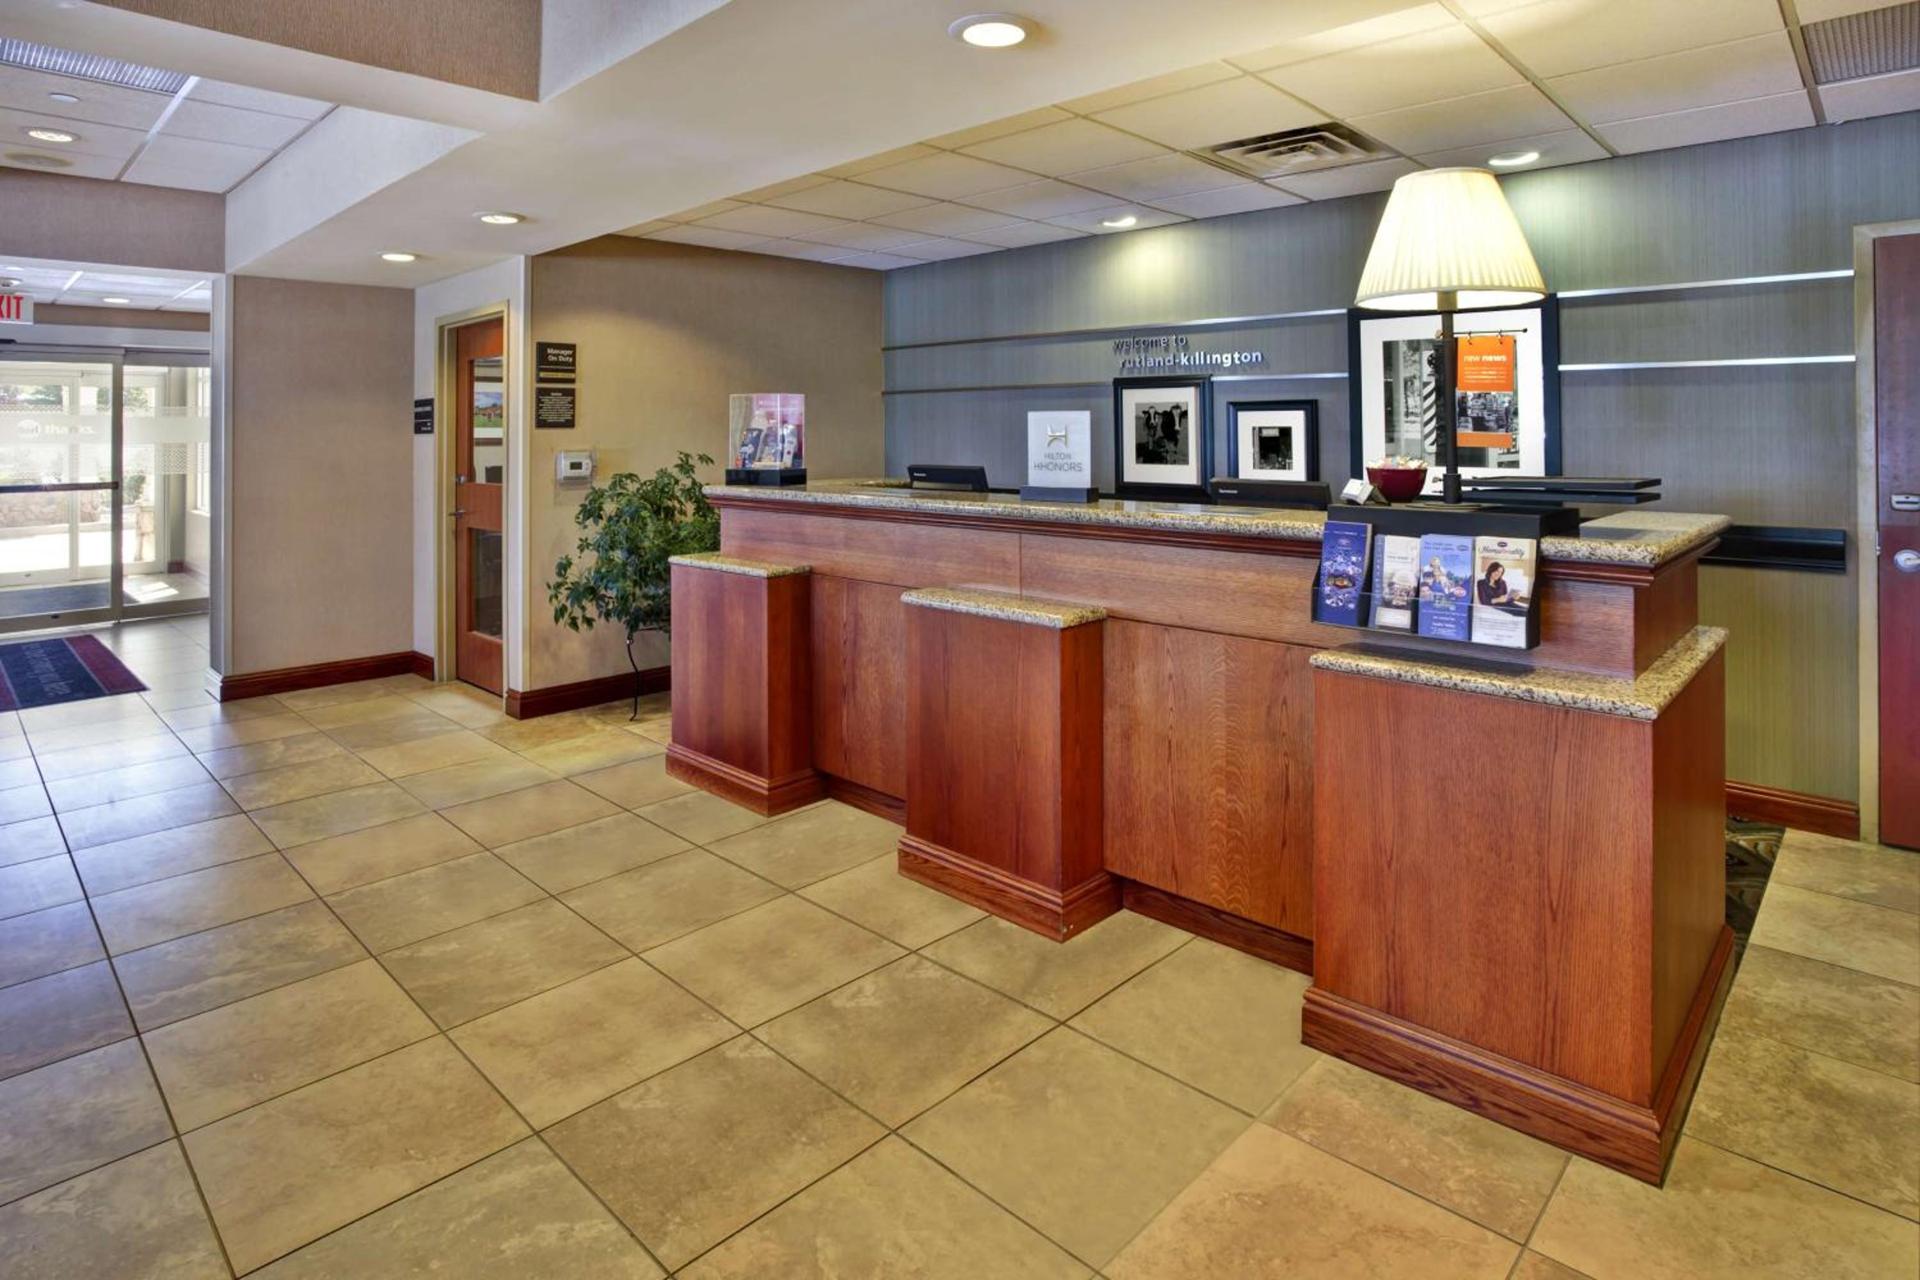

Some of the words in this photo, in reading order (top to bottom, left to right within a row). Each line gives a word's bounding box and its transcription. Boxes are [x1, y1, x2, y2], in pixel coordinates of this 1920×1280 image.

[1113, 336, 1168, 351] welcome
[1172, 334, 1188, 347] to
[546, 347, 574, 356] Manager
[558, 355, 573, 363] Duty
[1120, 351, 1262, 369] rutland-killington
[1043, 452, 1072, 460] HILTON
[1033, 461, 1083, 472] HHONORS
